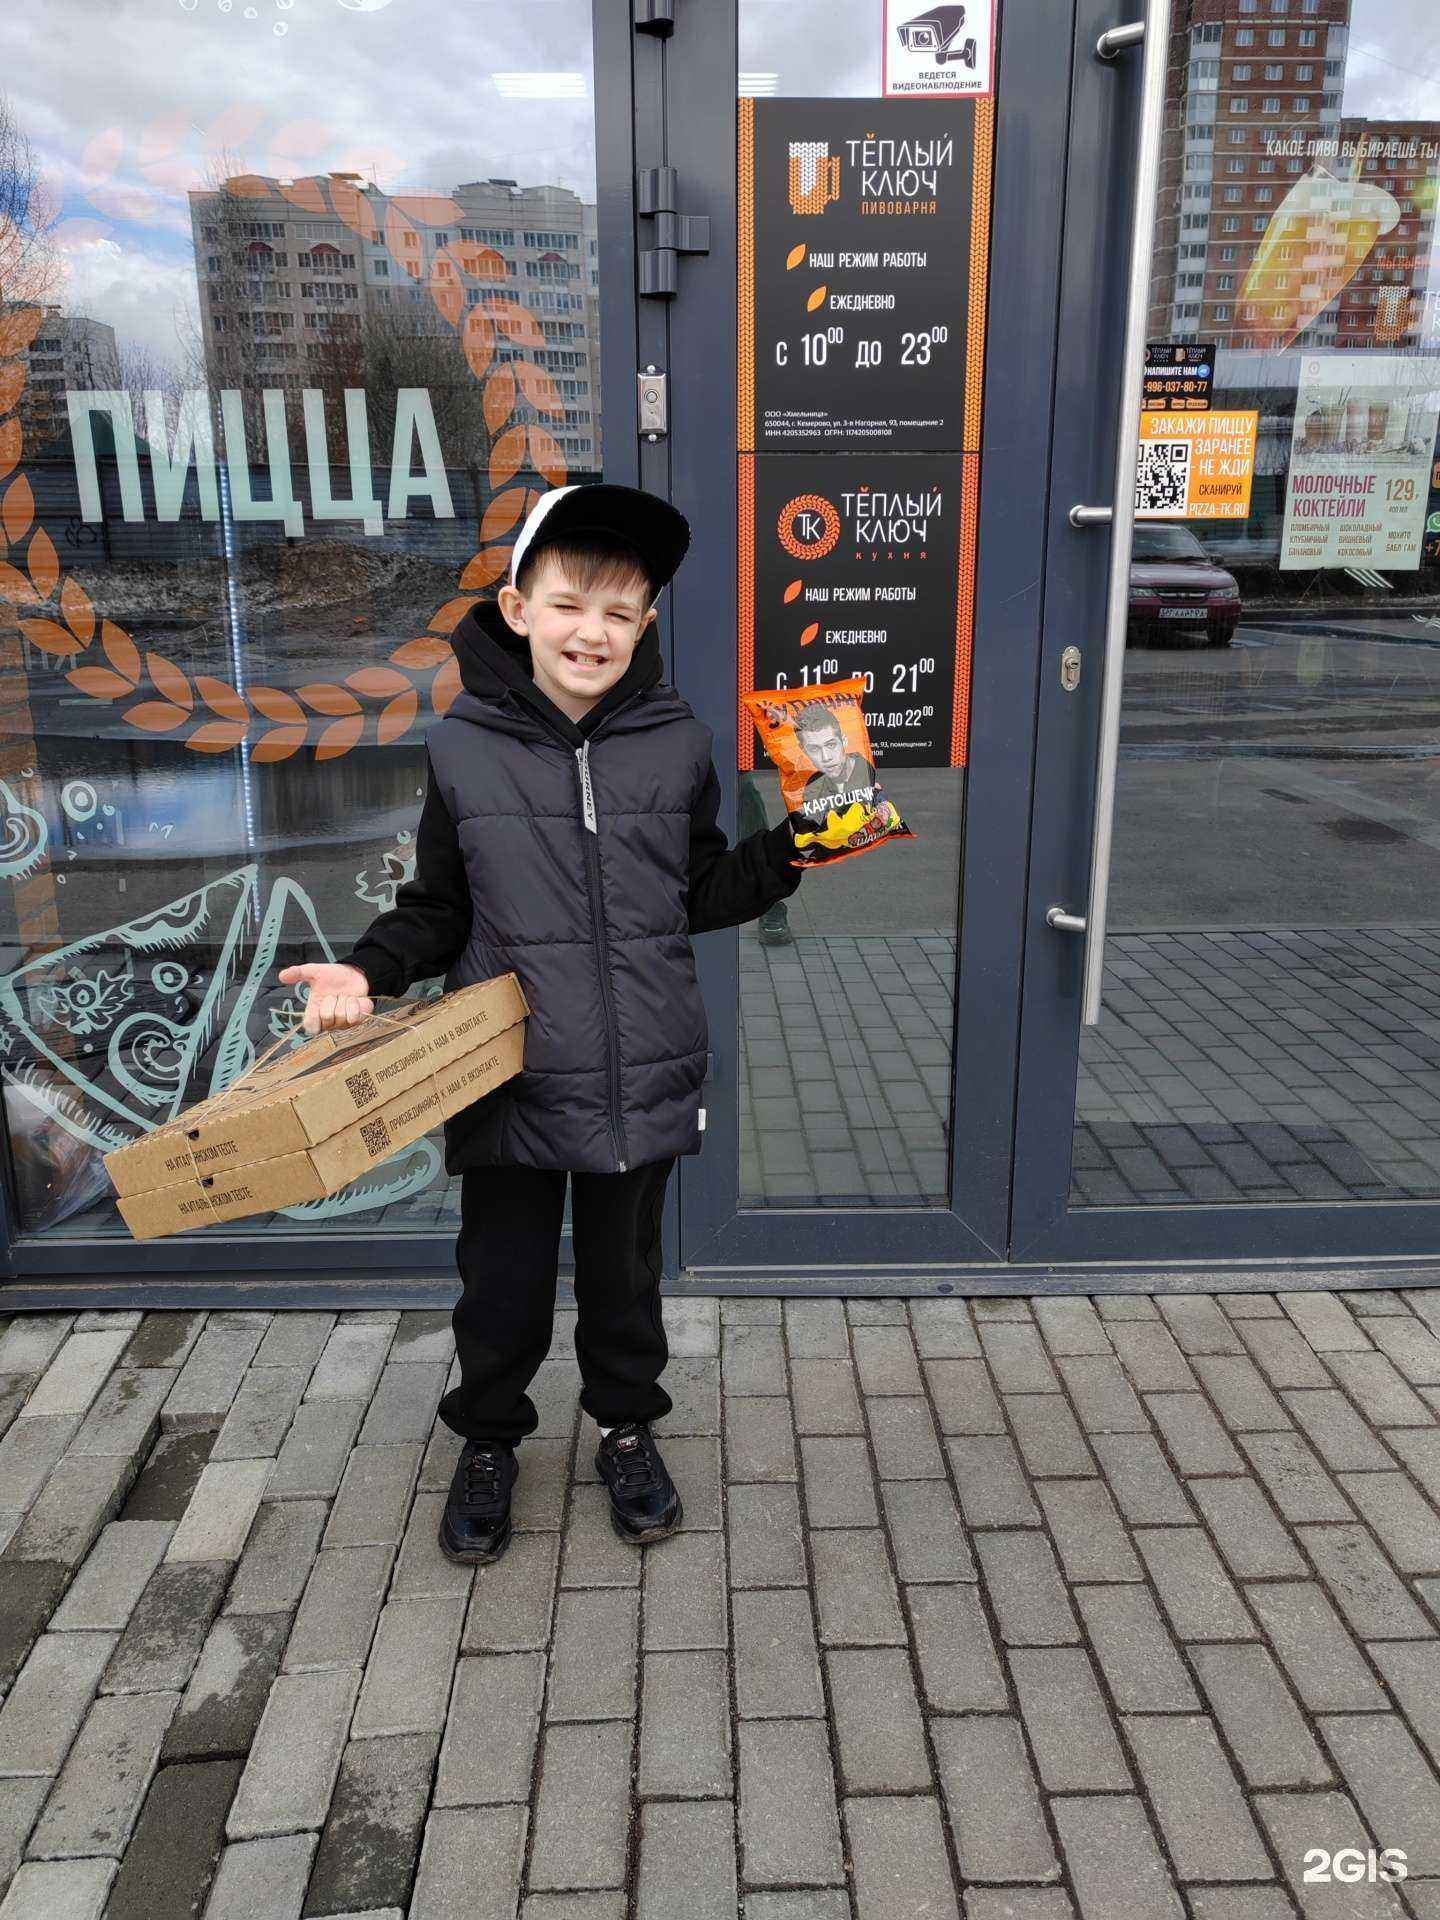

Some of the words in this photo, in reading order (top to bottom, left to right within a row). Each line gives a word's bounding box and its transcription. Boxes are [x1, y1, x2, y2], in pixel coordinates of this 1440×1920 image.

[919, 71, 957, 80] ВЕДЕТСЯ
[892, 81, 983, 91] ВИДЕОНАБЛЮДЕНИЕ
[846, 132, 953, 167] ТЁПЛЫЙ
[1266, 140, 1304, 157] КАКОЕ
[1306, 140, 1340, 157] ПИВО
[1341, 140, 1417, 159] ВЫБИРАЕШЬ
[862, 169, 937, 197] КЛЮЧ
[861, 201, 937, 215] ПИВОВАРНЯ
[809, 252, 834, 268] НАШ
[838, 252, 878, 268] РЕЖИМ
[883, 251, 927, 268] РАБОТЫ
[829, 294, 896, 311] ЕЖЕДНЕВНО
[855, 340, 882, 368] ДО
[1147, 366, 1183, 376] НАПИШИТЕ
[1183, 366, 1198, 376] НАМ
[797, 420, 832, 429] Кемерово,
[899, 419, 939, 428] помещение
[1151, 416, 1205, 435] ЗАКАЖИ
[1209, 416, 1254, 436] ПИЦЦУ
[1195, 438, 1252, 456] ЗАРАНЕЕ
[66, 387, 456, 538] ПИЦЦА
[1199, 458, 1215, 476] НЕ
[1219, 458, 1250, 477] ЖДИ
[1199, 482, 1242, 496] СКАНИРУЙ
[1292, 475, 1377, 494] МОЛОЧНЫЕ
[841, 485, 943, 517] ТЁПЛЫЙ
[1293, 495, 1366, 517] КОКТЕЙЛИ
[856, 519, 927, 543] КЛЮЧ
[805, 588, 828, 602] НАШ
[833, 587, 871, 602] РЕЖИМ
[875, 586, 917, 601] РАБОТЫ
[825, 630, 887, 646] ЕЖЕДНЕВНО
[887, 712, 903, 728] ДО
[802, 786, 876, 817] КАРТОШЕЧК
[375, 1046, 426, 1084] ПРИСОЕДИНЯЙСЯ
[434, 1035, 449, 1049] НАМ
[455, 1011, 489, 1037] ВКОНТАКТЕ
[389, 1092, 441, 1131] ПРИСОЕДИНЯЙСЯ
[446, 1080, 462, 1095] НАМ
[467, 1056, 501, 1081] ВКОНТАКТЕ
[173, 1145, 219, 1169] ИТАЛЯНСКОМ
[217, 1140, 240, 1157] ТЕСТЕ
[231, 1186, 254, 1202] ТЕСТЕ
